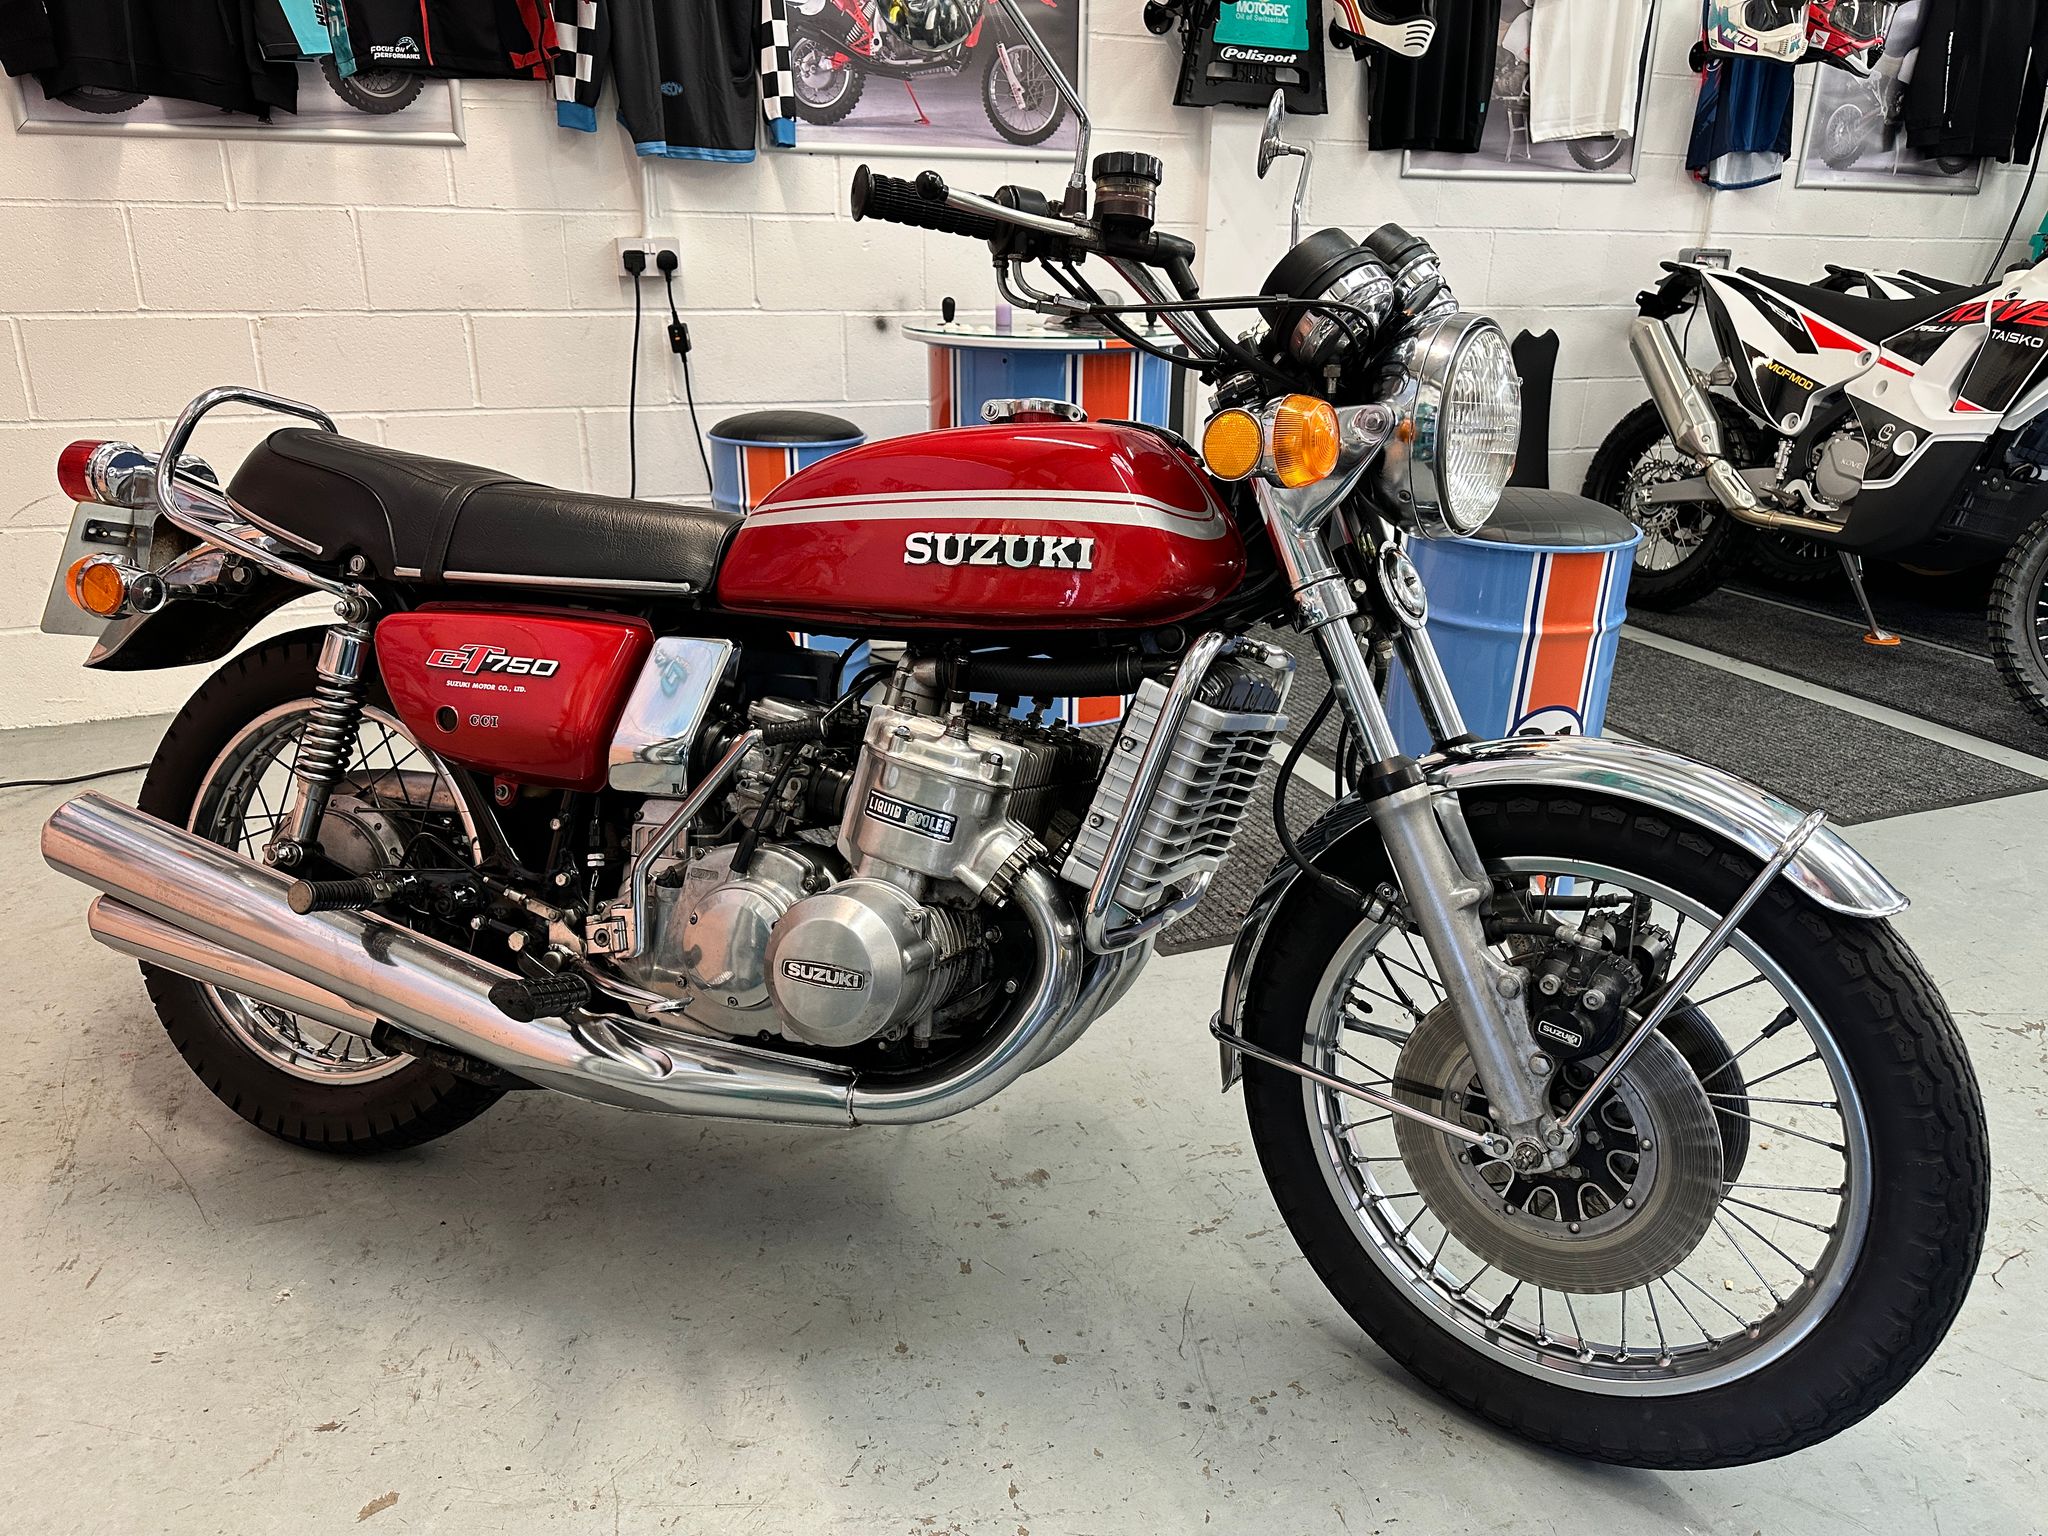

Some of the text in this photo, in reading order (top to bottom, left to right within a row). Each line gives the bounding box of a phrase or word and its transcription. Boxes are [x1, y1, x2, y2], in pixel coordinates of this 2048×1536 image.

[1236, 1, 1289, 17] MOTOREX
[1235, 12, 1245, 20] Oil
[1254, 14, 1289, 24] Switzerland
[370, 45, 405, 54] FOCUS ON
[374, 51, 420, 60] PERFORMANCE
[1224, 47, 1297, 63] Polisport
[1991, 329, 2044, 348] TAISKO
[1766, 361, 1814, 391] MOFMOD
[903, 531, 1095, 570] SUZUKI
[446, 680, 471, 689] SUZUKI
[471, 683, 496, 691] MOTOR
[498, 684, 512, 692] CO.,
[868, 796, 902, 819] LIQUID
[787, 962, 860, 988] SUZUKI
[1542, 1024, 1579, 1044] SUZUKI
